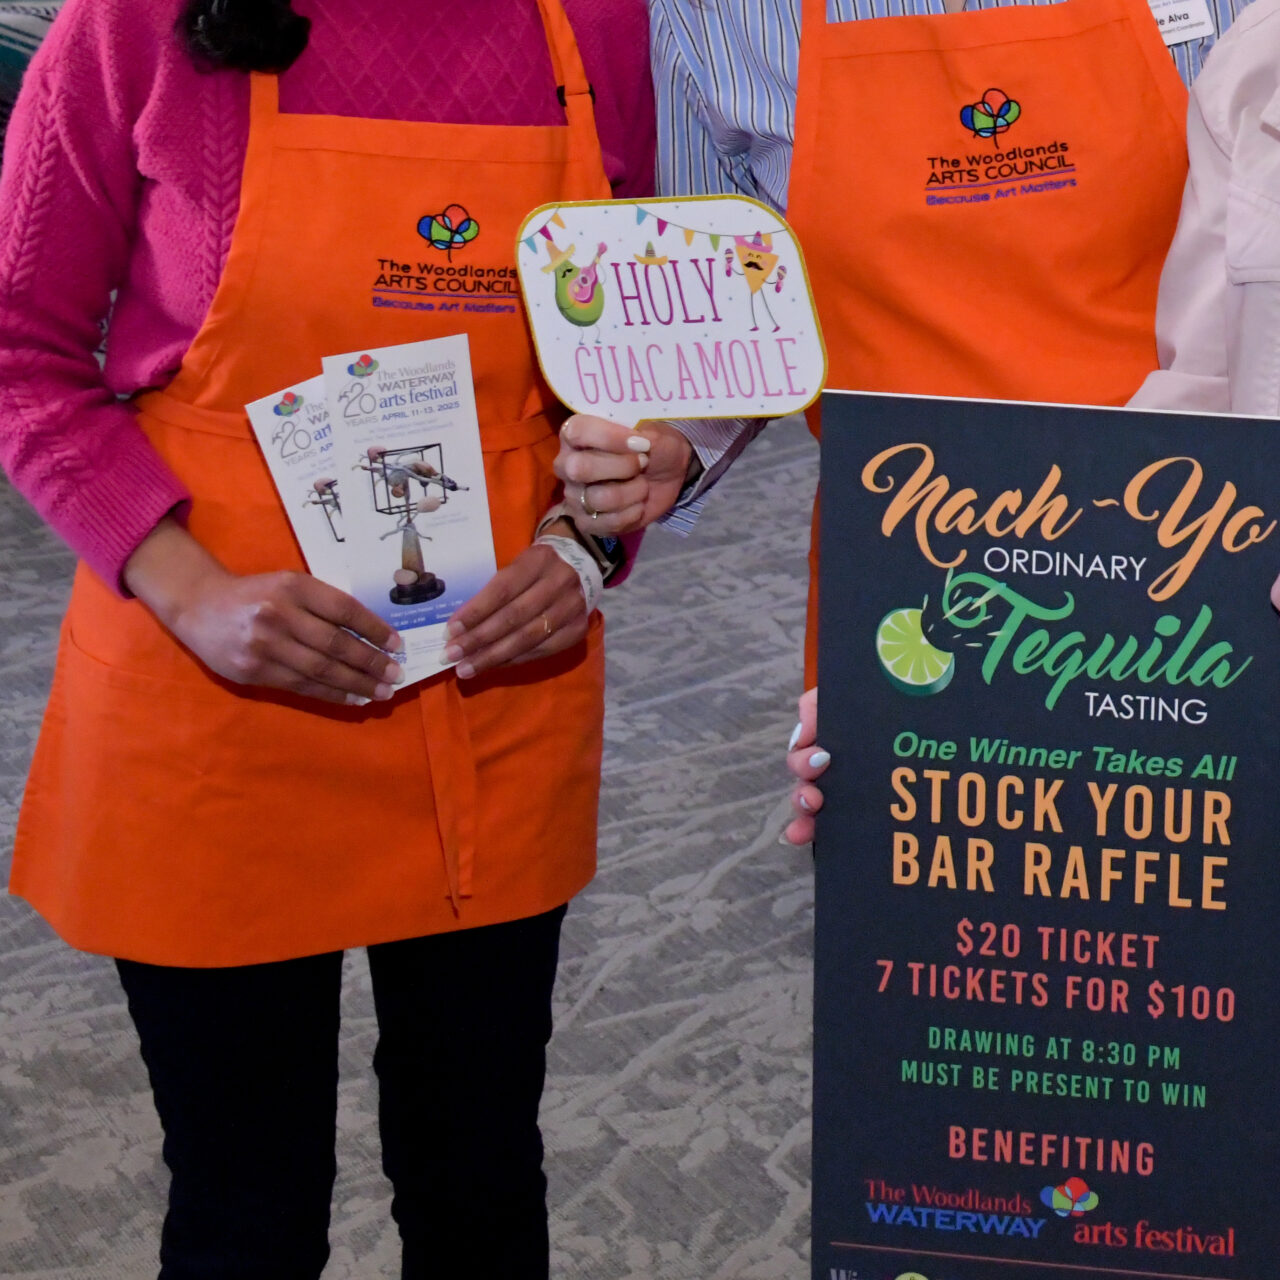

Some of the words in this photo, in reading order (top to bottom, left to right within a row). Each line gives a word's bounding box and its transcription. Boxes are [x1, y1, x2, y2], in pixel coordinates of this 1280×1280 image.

[926, 169, 979, 186] ARTS
[985, 155, 1075, 181] COUNCIL
[927, 156, 961, 171] The
[966, 141, 1069, 166] Woodlands
[926, 190, 990, 207] Because
[995, 187, 1018, 200] Art
[1020, 178, 1077, 196] Matters
[374, 274, 428, 291] ARTS
[433, 278, 519, 294] COUNCIL
[377, 259, 412, 274] The
[418, 262, 517, 279] Woodlands
[372, 296, 435, 311] Because
[438, 302, 460, 312] Art
[463, 303, 516, 313] Matters
[610, 258, 723, 326] HOLY
[378, 370, 396, 382] The
[399, 359, 456, 377] Woodlands
[378, 371, 456, 392] WATERWAY
[575, 337, 807, 404] GUACAMOLE
[379, 395, 407, 410] arts
[409, 381, 458, 405] festival
[381, 410, 409, 422] APRIL
[438, 400, 460, 411] 2025
[861, 442, 1277, 601] Nach-Yo
[983, 547, 1147, 582] ORDINARY
[942, 570, 1253, 711] Tequila
[1085, 692, 1208, 724] TASTING
[892, 731, 957, 761] One
[969, 736, 1081, 770] Winner
[1092, 746, 1183, 777] Takes
[1191, 754, 1237, 781] All
[890, 766, 1065, 834] STOCK
[1087, 780, 1232, 845] YOUR
[891, 831, 995, 893] BAR
[1023, 842, 1229, 910] RAFFLE
[956, 917, 1021, 959] $20
[1037, 926, 1160, 969] TICKET
[875, 959, 894, 993] 7
[907, 962, 1049, 1007] TICKETS
[1065, 975, 1129, 1013] FOR
[1147, 980, 1235, 1022] $100
[928, 1026, 1035, 1058] DRAWING
[1045, 1036, 1071, 1061] AT
[1082, 1040, 1136, 1066] 8:30
[1147, 1045, 1181, 1070] PM
[901, 1059, 962, 1087] MUST
[972, 1066, 1000, 1091] BE
[1011, 1070, 1113, 1100] PRESENT
[1123, 1079, 1150, 1104] TO
[1161, 1083, 1207, 1108] WIN
[948, 1125, 1155, 1176] BENEFITING
[865, 1179, 905, 1201] The
[911, 1183, 1032, 1215] Woodlands
[865, 1202, 1046, 1239] WATERWAY
[1073, 1221, 1128, 1249] arts
[1134, 1220, 1235, 1257] festival
